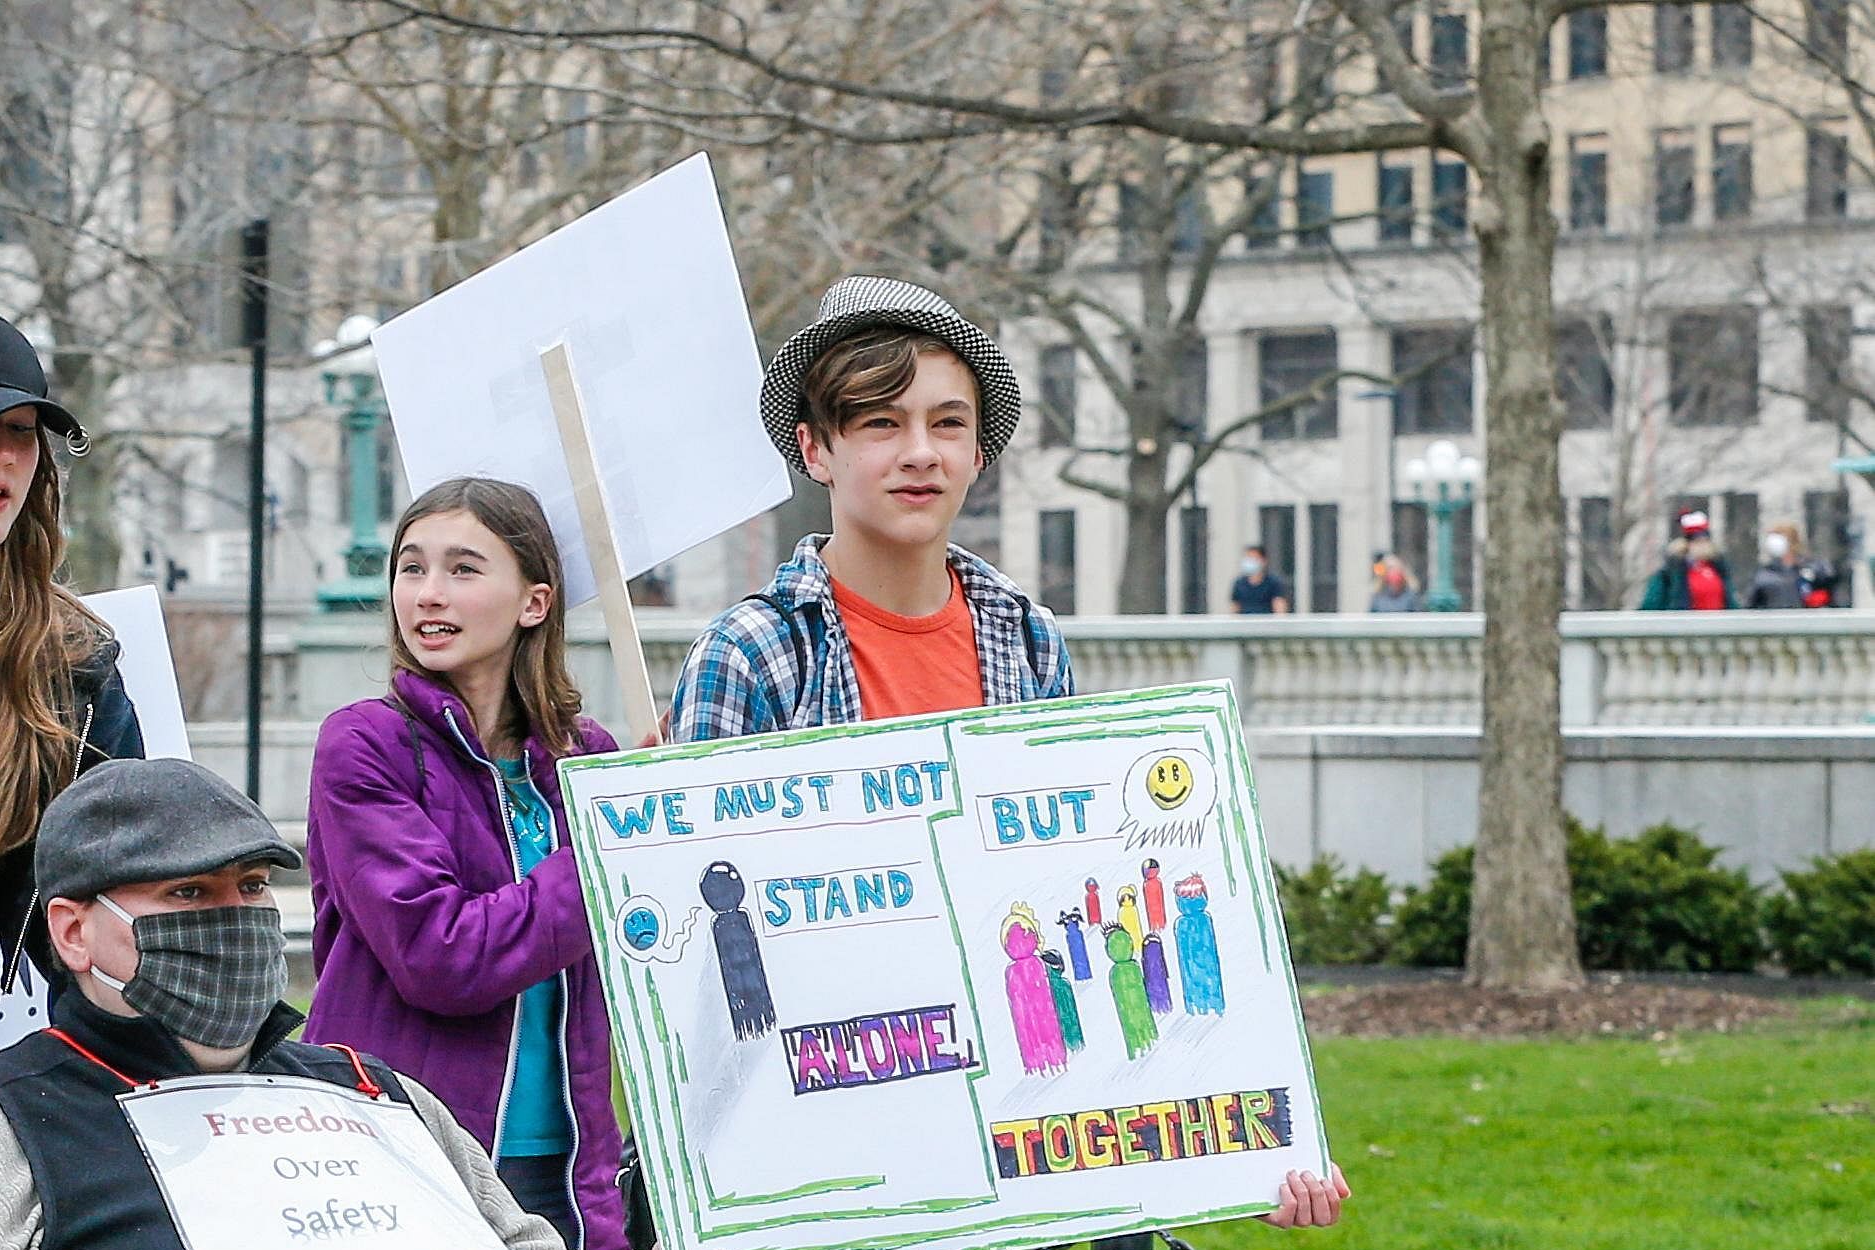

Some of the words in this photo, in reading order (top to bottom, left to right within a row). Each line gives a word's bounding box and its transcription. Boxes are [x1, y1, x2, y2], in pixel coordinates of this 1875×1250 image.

[596, 791, 693, 839] WE
[714, 775, 834, 821] MUST
[861, 759, 950, 813] NOT
[993, 788, 1096, 846] BUT
[763, 869, 916, 928] STAND
[203, 1106, 379, 1139] Freedom
[991, 1089, 1280, 1177] TOGETHER
[273, 1157, 361, 1180] Over
[282, 1199, 398, 1234] Safety
